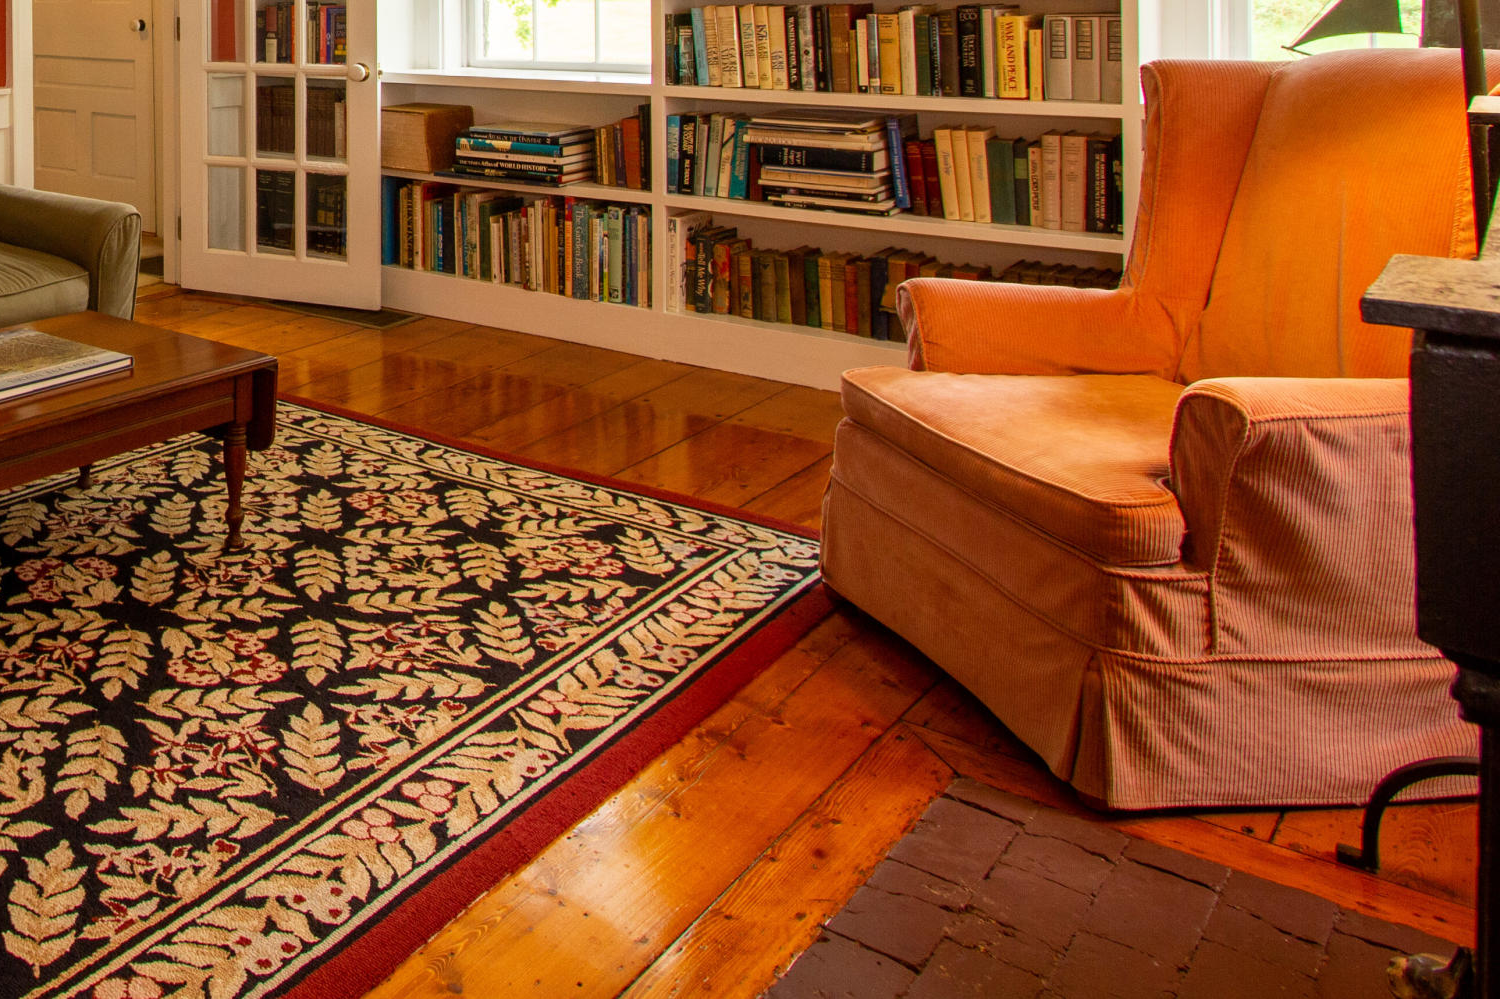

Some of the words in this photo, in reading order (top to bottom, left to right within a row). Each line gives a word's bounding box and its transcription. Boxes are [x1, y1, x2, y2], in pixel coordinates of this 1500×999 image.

[756, 24, 768, 41] 1876
[1005, 21, 1015, 42] WAR
[1006, 43, 1016, 63] AND
[1007, 64, 1018, 92] PEACE
[499, 162, 521, 170] WORLD
[521, 164, 548, 172] HISTORY
[575, 208, 584, 225] The
[575, 226, 584, 256] Garden
[575, 258, 584, 278] Book
[698, 253, 706, 265] Tell
[698, 267, 706, 278] Me
[695, 279, 706, 297] Why
